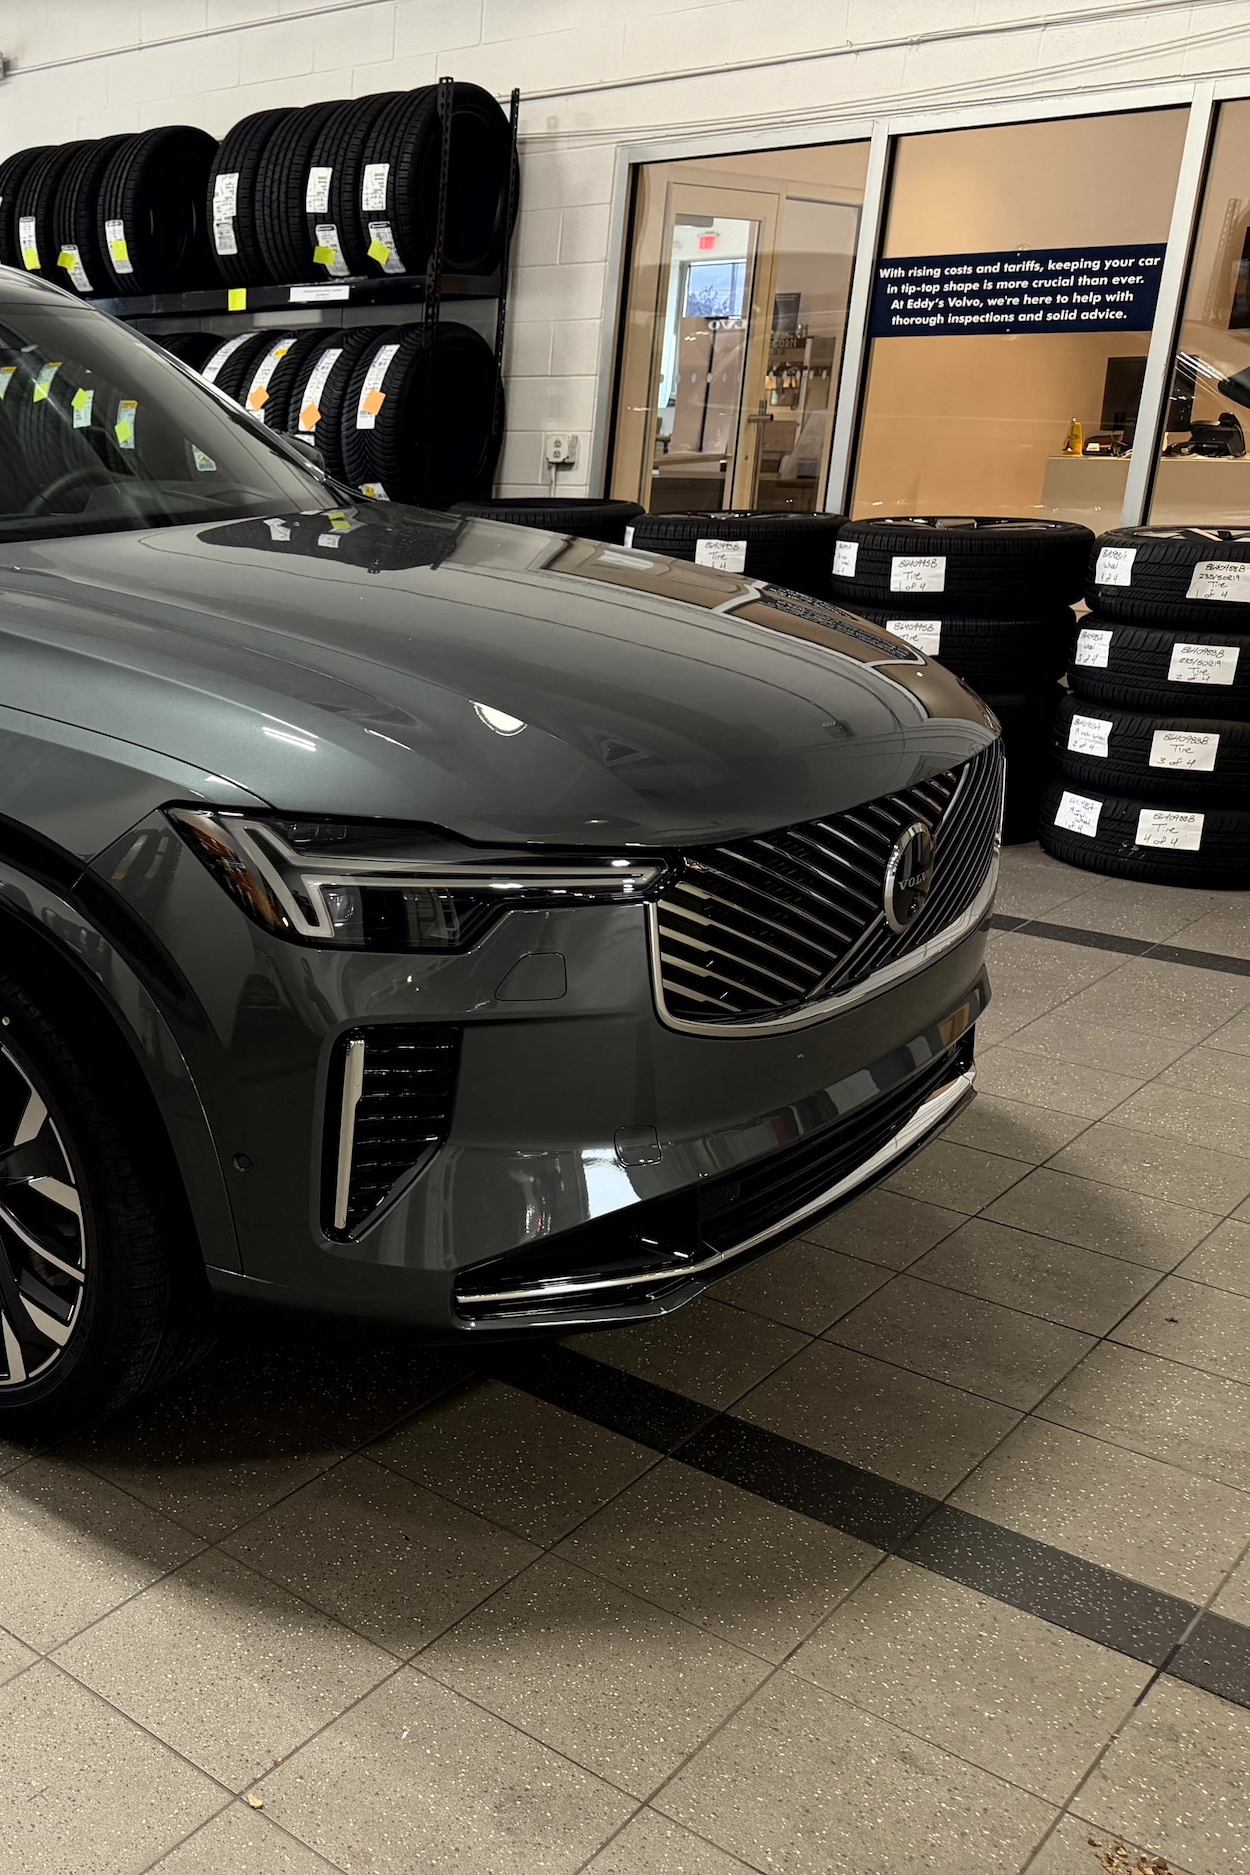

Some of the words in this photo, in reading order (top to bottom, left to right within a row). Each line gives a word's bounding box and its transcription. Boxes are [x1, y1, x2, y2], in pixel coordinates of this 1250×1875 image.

[879, 266, 905, 279] With
[908, 265, 941, 280] rising
[944, 264, 973, 276] costs
[976, 262, 1000, 274] and
[1003, 260, 1045, 274] tariffs,
[1048, 258, 1100, 274] keeping
[1104, 258, 1135, 271] your
[1138, 256, 1161, 267] car
[886, 283, 898, 294] in
[900, 281, 940, 296] tip-top
[943, 279, 980, 294] shape
[983, 279, 993, 290] is
[996, 278, 1029, 290] more
[1032, 275, 1074, 288] crucial
[1077, 275, 1109, 287] than
[1111, 273, 1145, 285] ever.
[891, 299, 904, 310] At
[948, 297, 984, 309] Volvo,
[987, 295, 1020, 307] we're
[1023, 294, 1052, 305] here
[1055, 293, 1068, 304] to
[1072, 291, 1102, 305] help
[1105, 290, 1134, 302] with
[891, 314, 944, 327] thorough
[947, 311, 1015, 325] inspections
[1018, 310, 1043, 322] and
[1046, 309, 1078, 320] solid
[1080, 308, 1127, 320] advice.
[1170, 743, 1195, 753] Tire
[1169, 757, 1183, 766] of
[1186, 759, 1196, 768] 4
[1152, 823, 1179, 834] Tire
